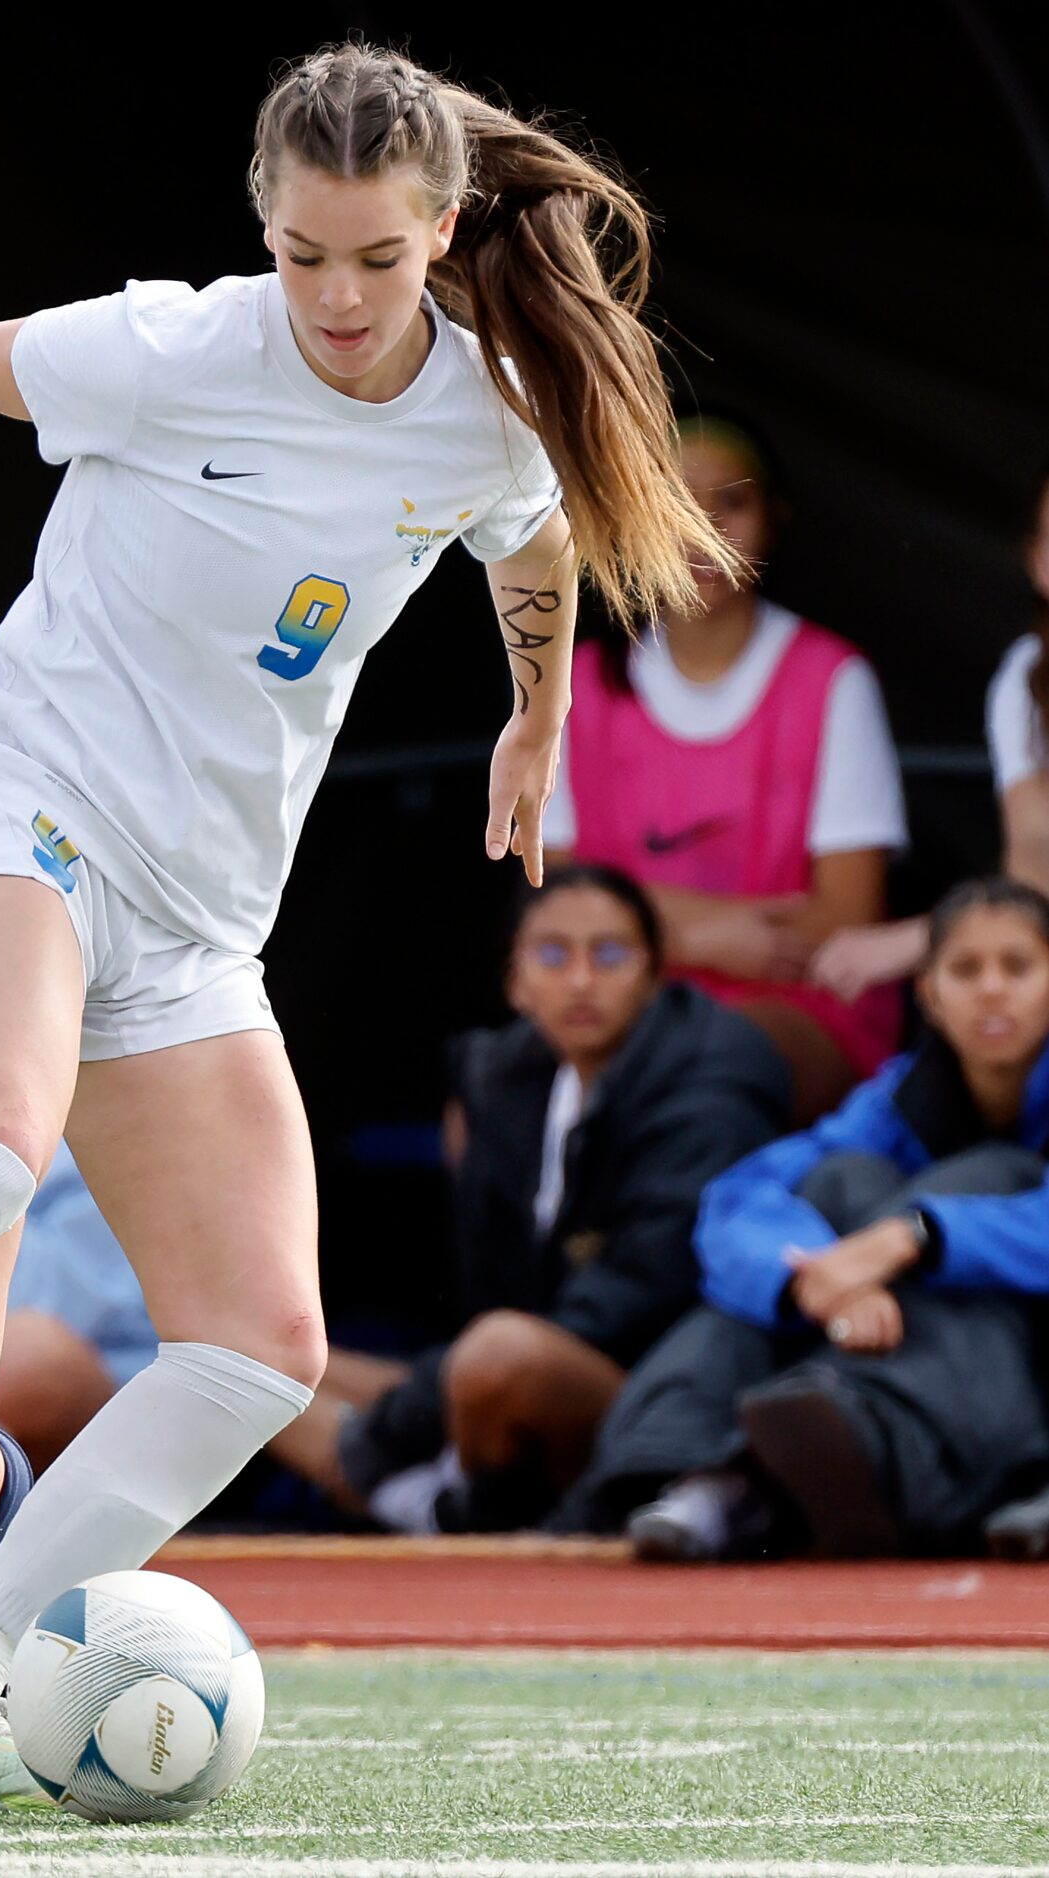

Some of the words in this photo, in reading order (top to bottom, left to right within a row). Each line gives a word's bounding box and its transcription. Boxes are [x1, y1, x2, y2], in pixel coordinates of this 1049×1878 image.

[256, 573, 350, 681] 9
[31, 809, 82, 894] 9
[150, 1701, 175, 1776] Baden
